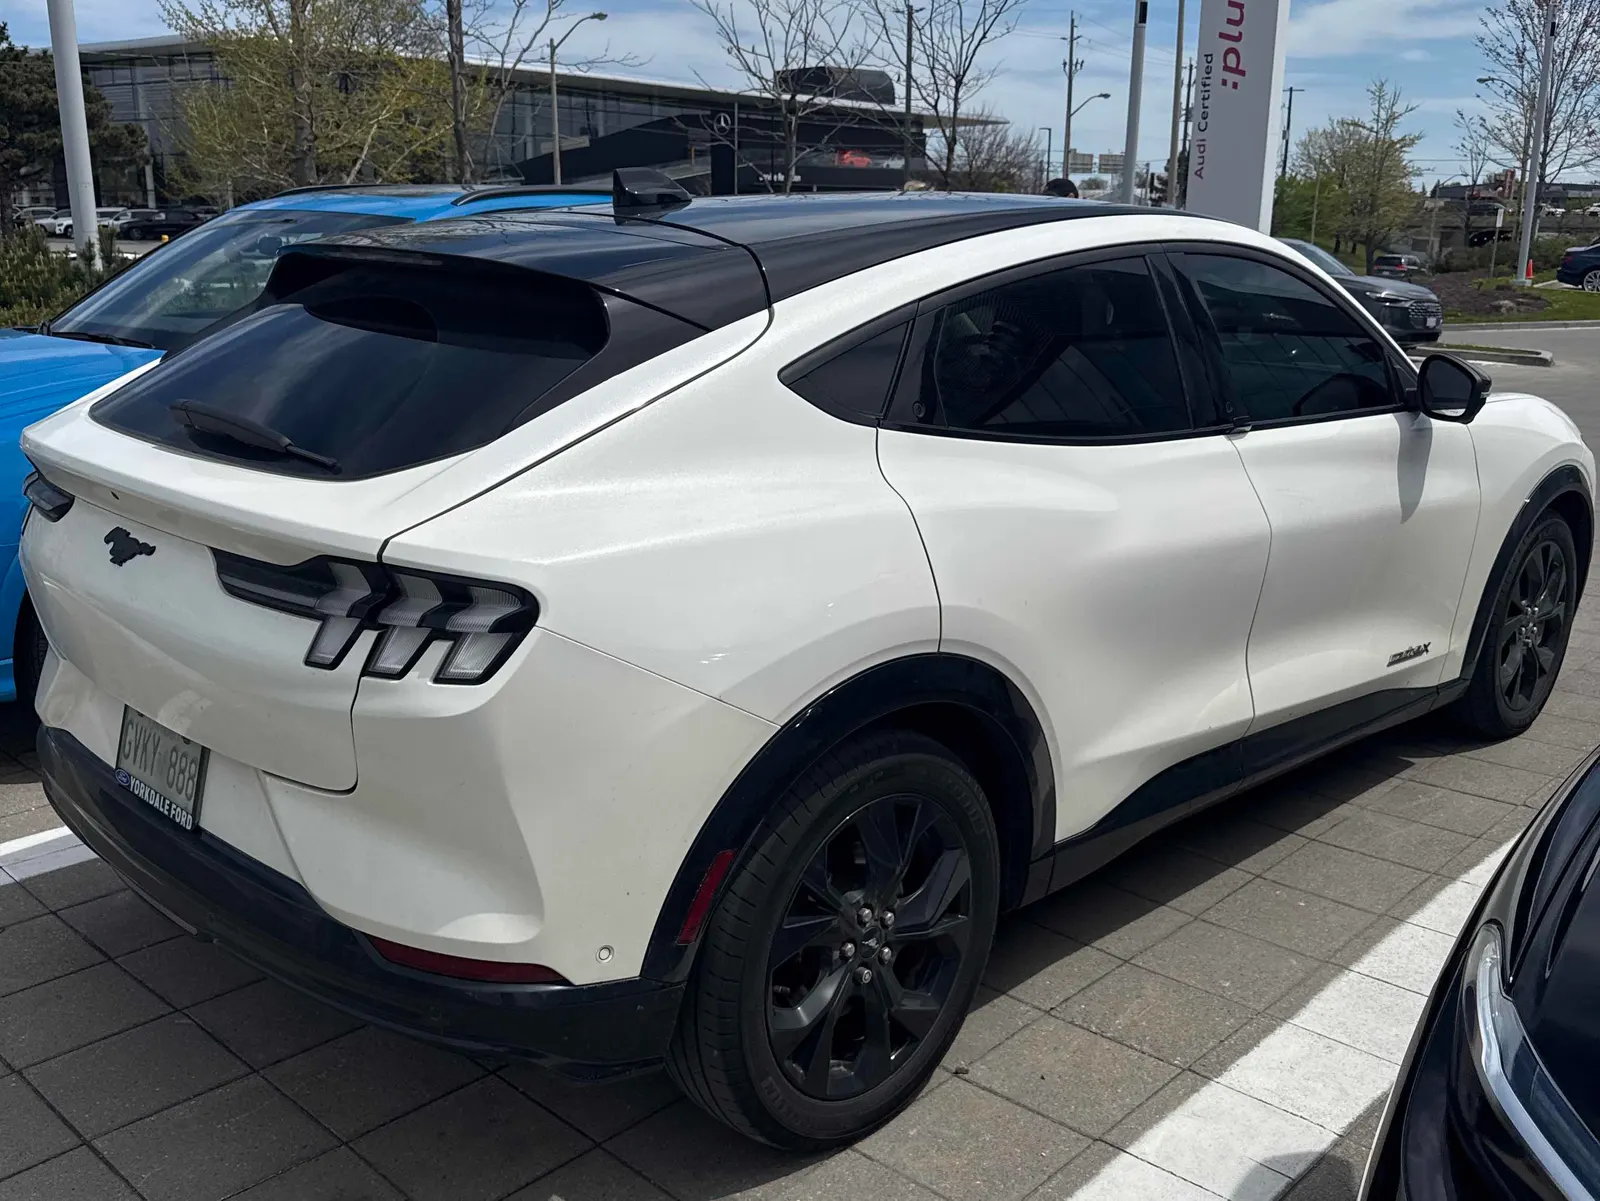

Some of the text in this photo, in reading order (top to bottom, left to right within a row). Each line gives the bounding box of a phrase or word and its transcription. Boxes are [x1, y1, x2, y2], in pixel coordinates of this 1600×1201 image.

[1194, 53, 1213, 180] Audi Certified
[121, 719, 198, 801] GVKY 888
[129, 775, 170, 815] YORKDALE
[170, 803, 193, 831] FORD
